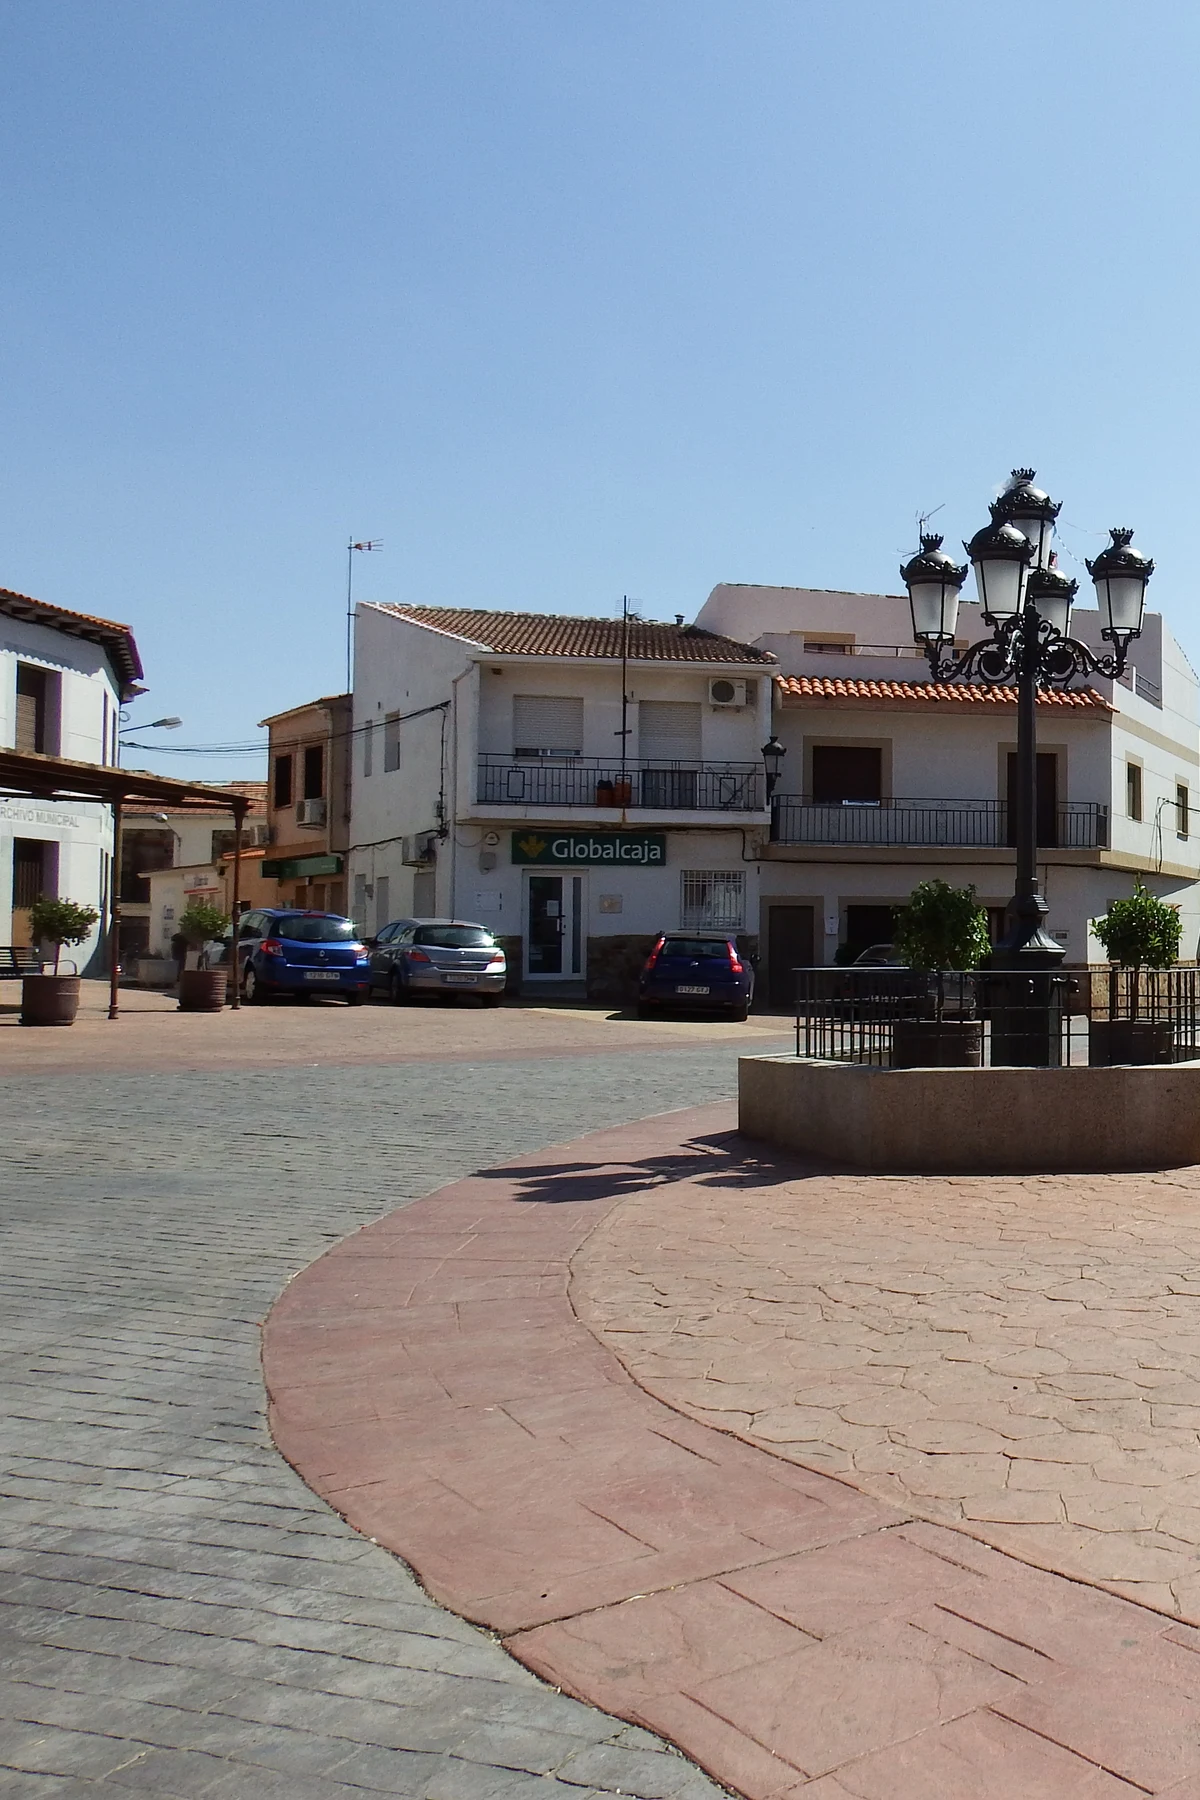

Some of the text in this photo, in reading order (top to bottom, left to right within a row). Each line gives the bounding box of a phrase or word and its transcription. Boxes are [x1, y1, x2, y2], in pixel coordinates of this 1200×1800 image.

[0, 806, 80, 828] RCHIVO MUNICIPAL
[552, 838, 661, 863] Globalcaja
